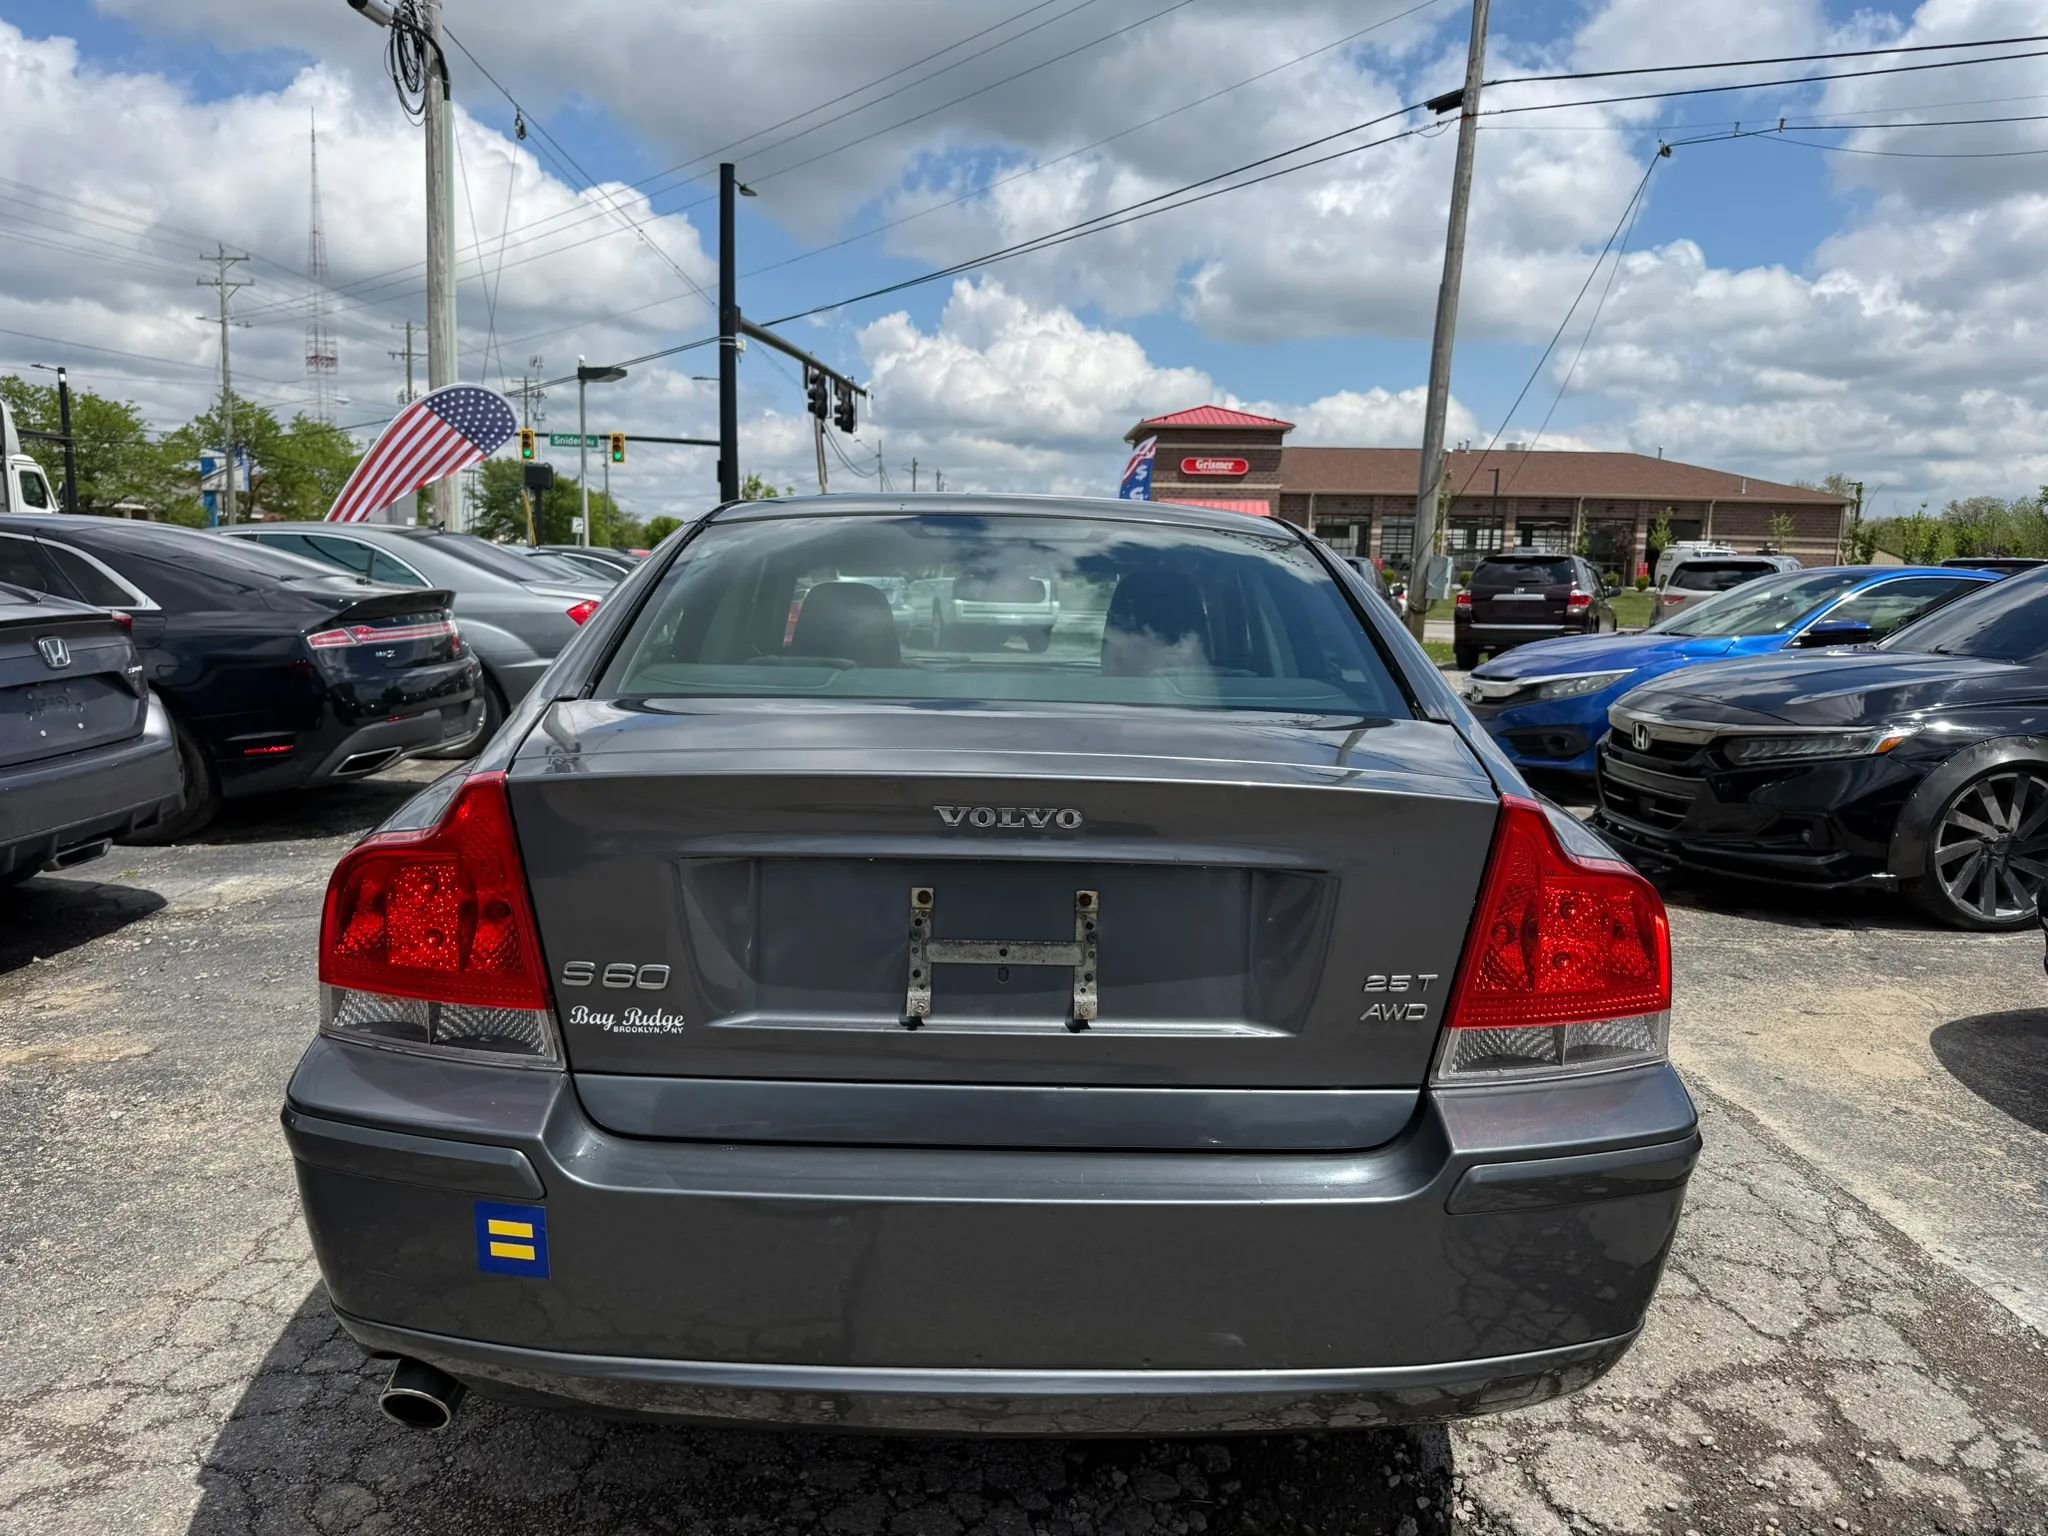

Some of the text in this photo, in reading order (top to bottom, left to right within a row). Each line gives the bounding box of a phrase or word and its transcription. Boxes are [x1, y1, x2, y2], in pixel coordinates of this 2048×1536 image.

[1195, 458, 1235, 470] Grismer
[933, 805, 1083, 829] VOLVO
[569, 1005, 685, 1032] Bay Ridge
[1359, 1003, 1428, 1021] AWD
